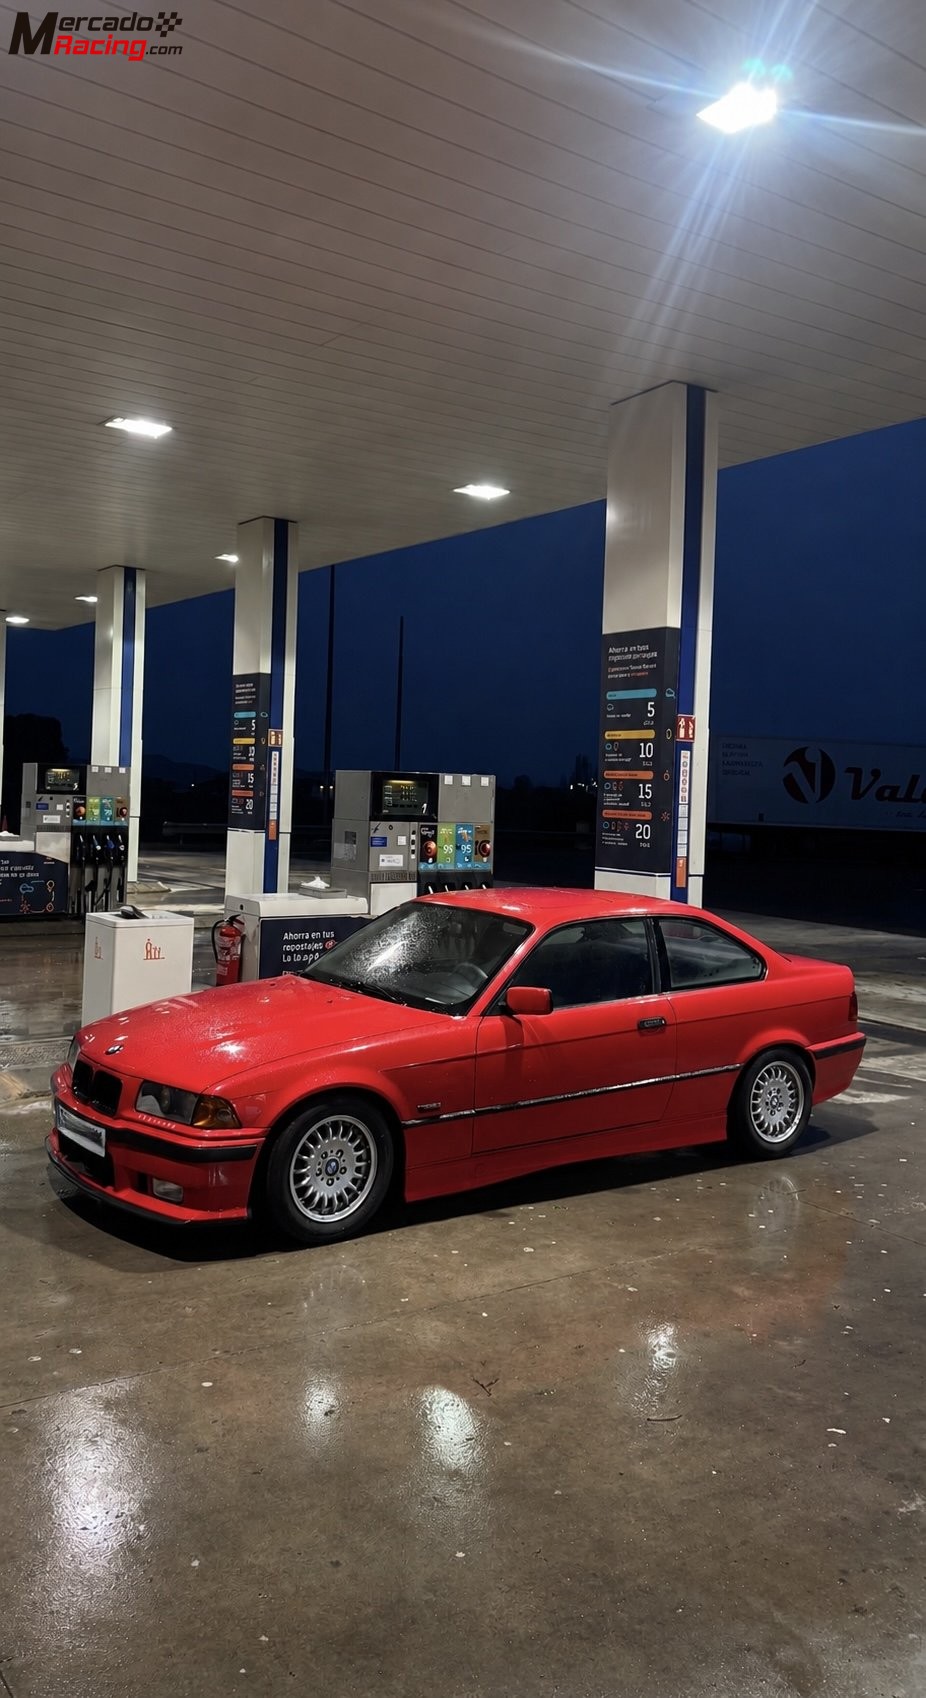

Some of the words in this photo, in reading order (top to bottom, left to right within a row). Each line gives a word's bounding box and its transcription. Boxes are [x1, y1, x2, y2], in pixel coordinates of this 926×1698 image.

[647, 701, 655, 717] 5
[639, 742, 654, 758] 10
[247, 772, 254, 783] 15
[638, 783, 652, 799] 15
[844, 767, 926, 803] Val
[245, 798, 254, 810] 20
[421, 803, 428, 814] 1
[635, 823, 651, 839] 20
[460, 844, 472, 854] 95
[283, 931, 310, 940] Ahorra
[322, 930, 335, 938] tus
